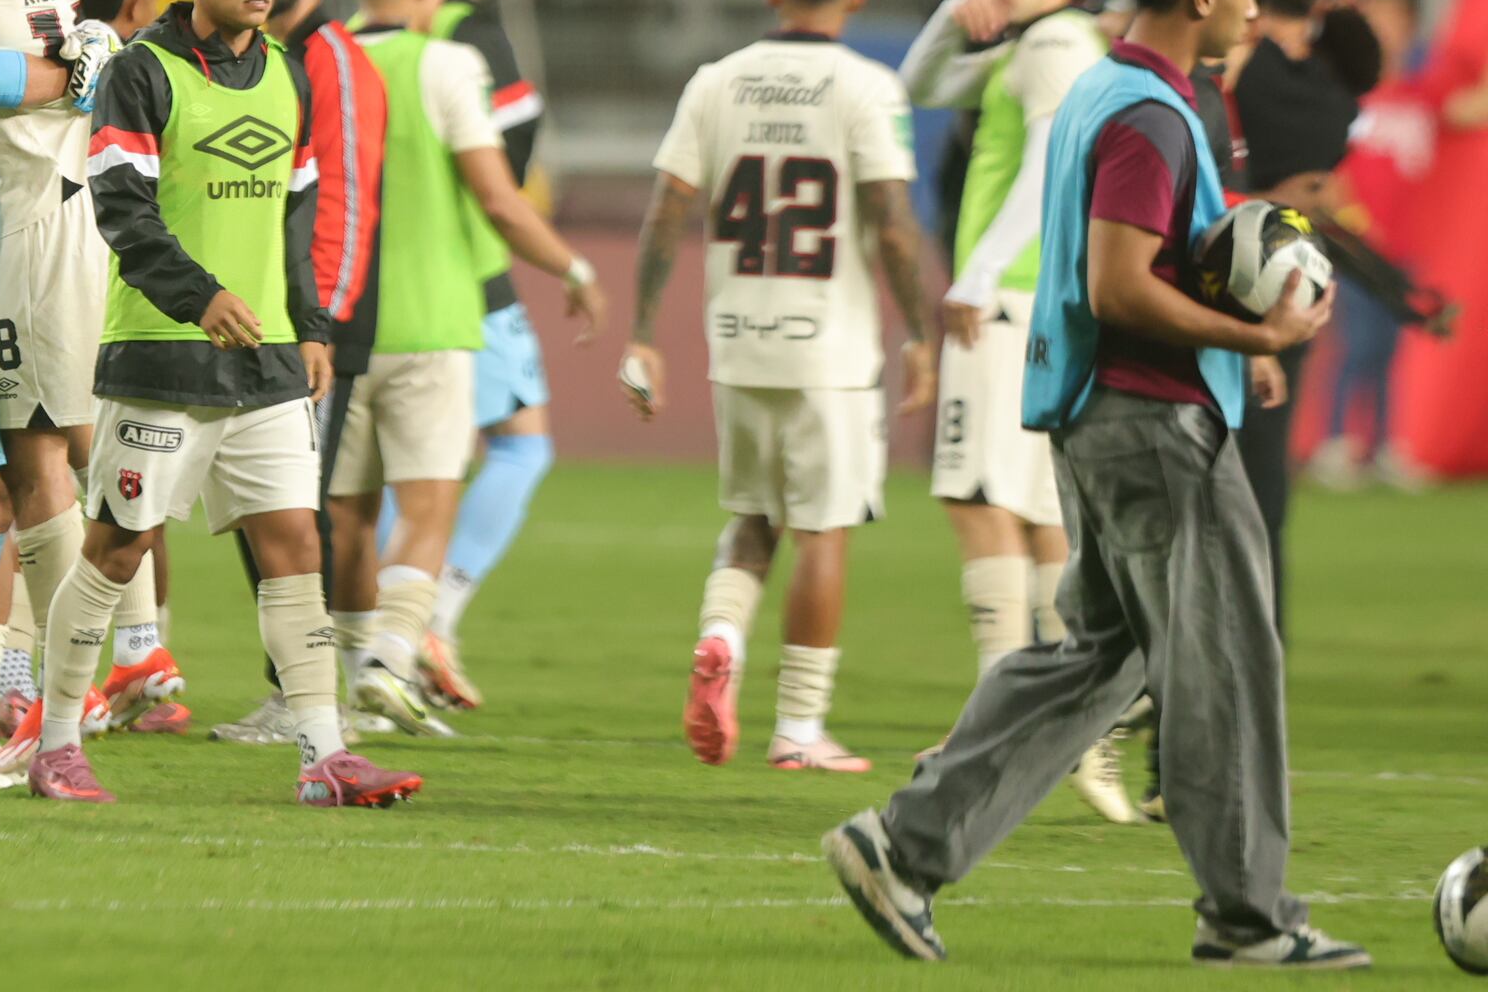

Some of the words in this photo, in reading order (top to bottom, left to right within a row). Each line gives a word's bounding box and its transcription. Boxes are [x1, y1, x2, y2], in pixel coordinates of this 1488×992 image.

[728, 73, 835, 111] Tropical
[207, 174, 282, 200] umbro
[714, 155, 838, 279] 42
[716, 313, 819, 341] BYD
[121, 423, 182, 449] ABUS
